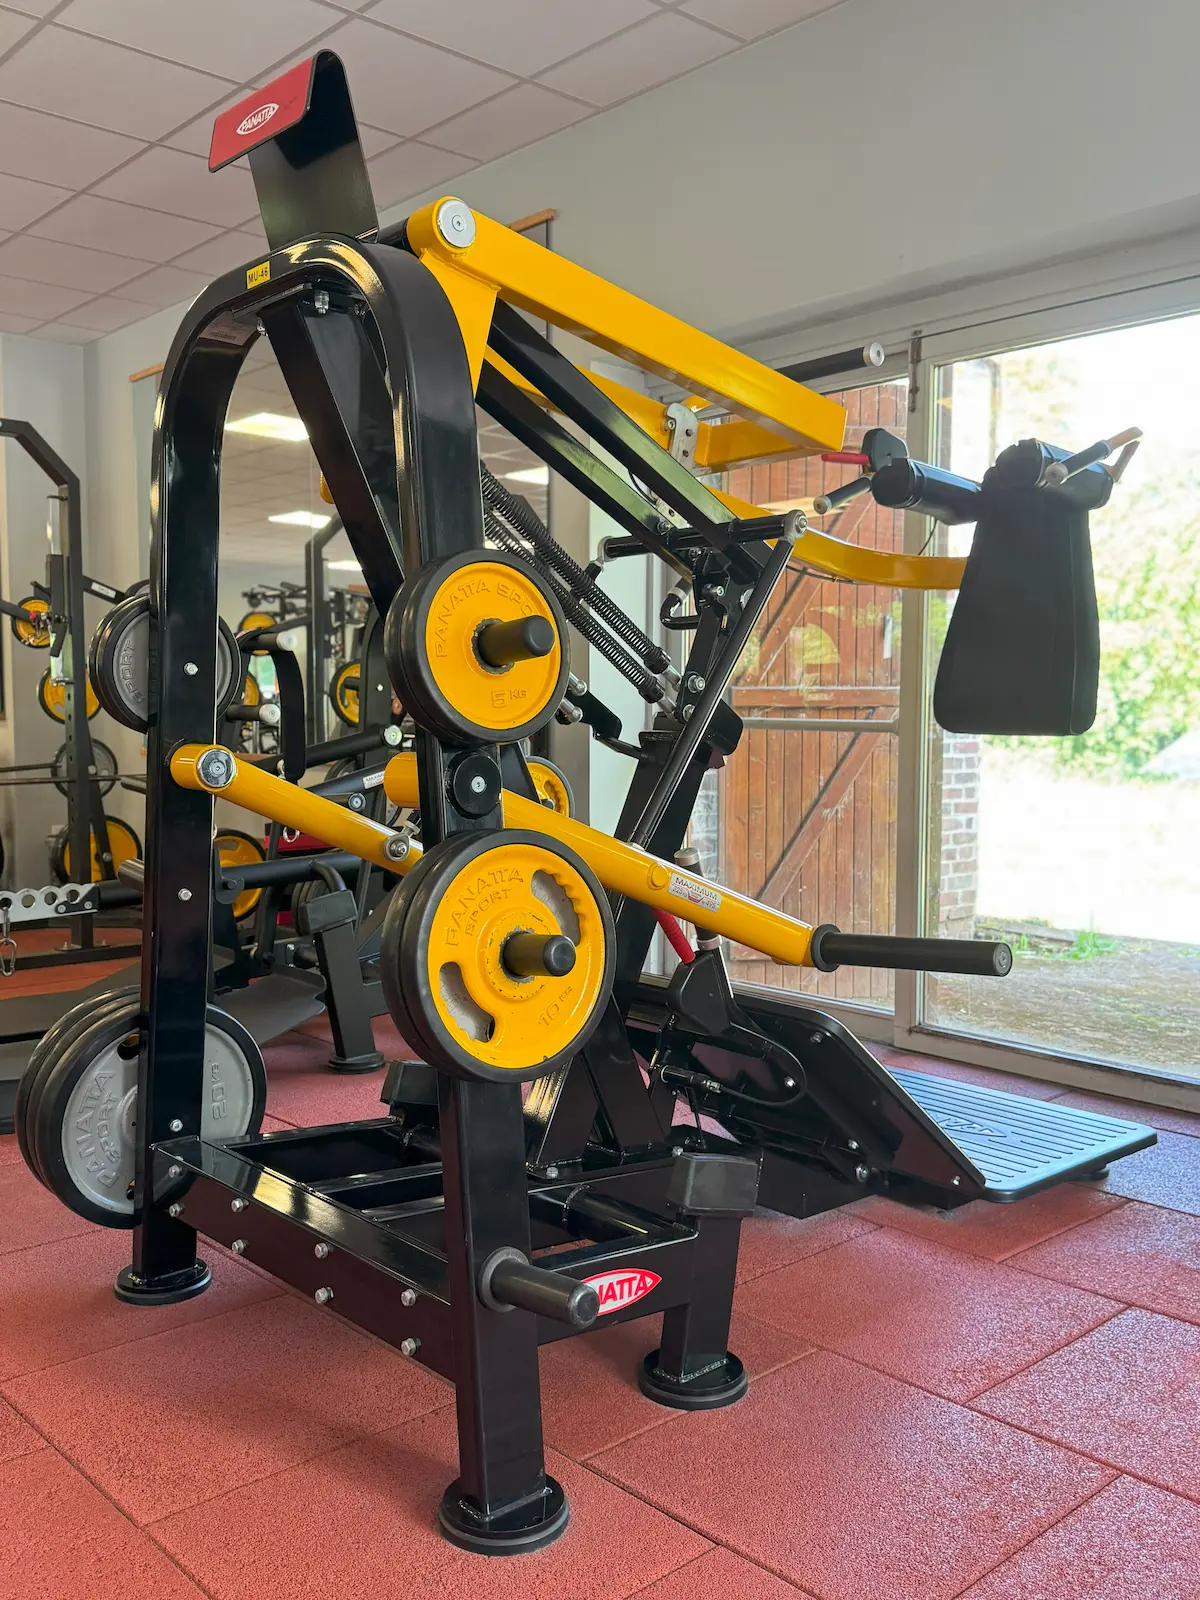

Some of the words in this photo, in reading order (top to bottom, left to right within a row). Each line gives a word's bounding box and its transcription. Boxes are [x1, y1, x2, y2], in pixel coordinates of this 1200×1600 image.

[239, 106, 275, 131] PANATTA
[247, 266, 268, 284] MU-46
[434, 578, 492, 658] PANATTA
[496, 582, 534, 616] SPO
[120, 640, 145, 702] SPORT
[491, 689, 507, 709] 5
[446, 868, 524, 946] PANATTA
[675, 877, 717, 901] MAXIMUM
[465, 890, 512, 935] SPORT
[538, 1003, 560, 1027] 10
[211, 1083, 227, 1120] 20
[75, 1071, 119, 1188] PANATTA
[96, 1090, 121, 1164] SPORT
